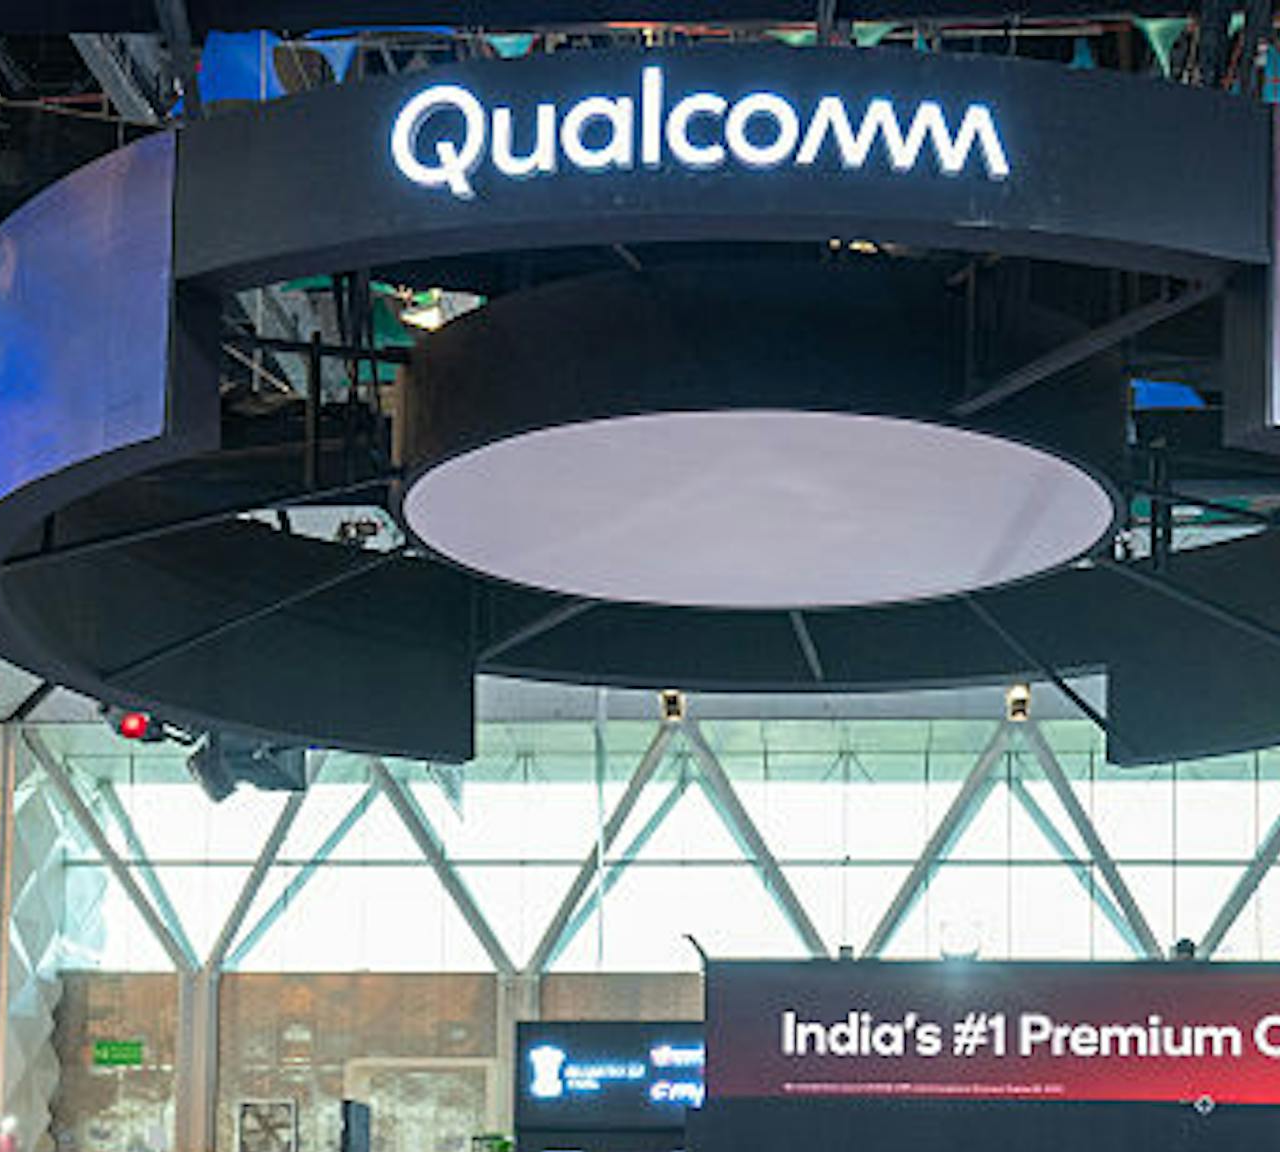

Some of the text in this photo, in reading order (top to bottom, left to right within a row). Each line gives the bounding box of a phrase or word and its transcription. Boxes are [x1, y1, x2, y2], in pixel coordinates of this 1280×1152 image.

[390, 66, 1010, 198] Qualcomm
[781, 1010, 943, 1057] India's
[952, 1012, 1006, 1057] #1
[1019, 1014, 1243, 1058] Premium
